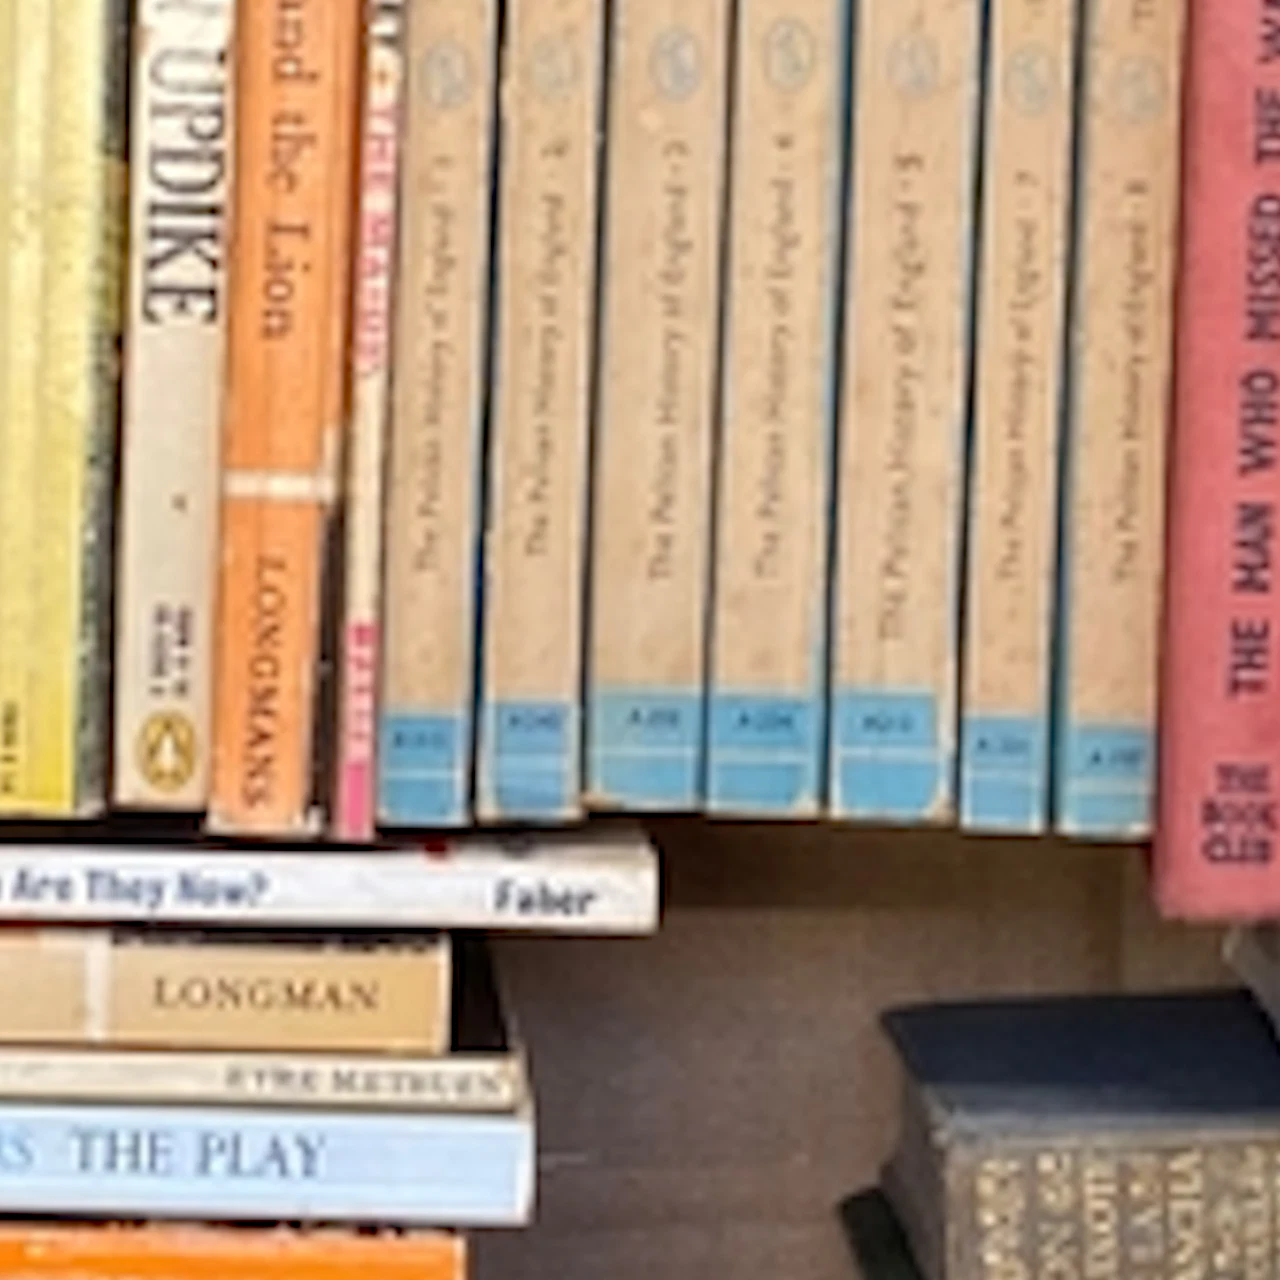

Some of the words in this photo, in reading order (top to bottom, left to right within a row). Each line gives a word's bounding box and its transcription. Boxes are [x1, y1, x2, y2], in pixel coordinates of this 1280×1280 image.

[143, 47, 228, 326] UPDIKE
[265, 110, 318, 196] the
[260, 220, 312, 343] Lion
[1231, 501, 1276, 596] MAN
[241, 554, 288, 810] LONGMANS
[1227, 617, 1273, 699] THE
[12, 868, 75, 902] Are
[85, 869, 168, 910] They
[176, 871, 270, 908] Now?
[494, 879, 600, 917] Faber
[151, 974, 384, 1012] LONGMAN
[70, 1125, 173, 1177] THE
[196, 1129, 328, 1180] PLAY
